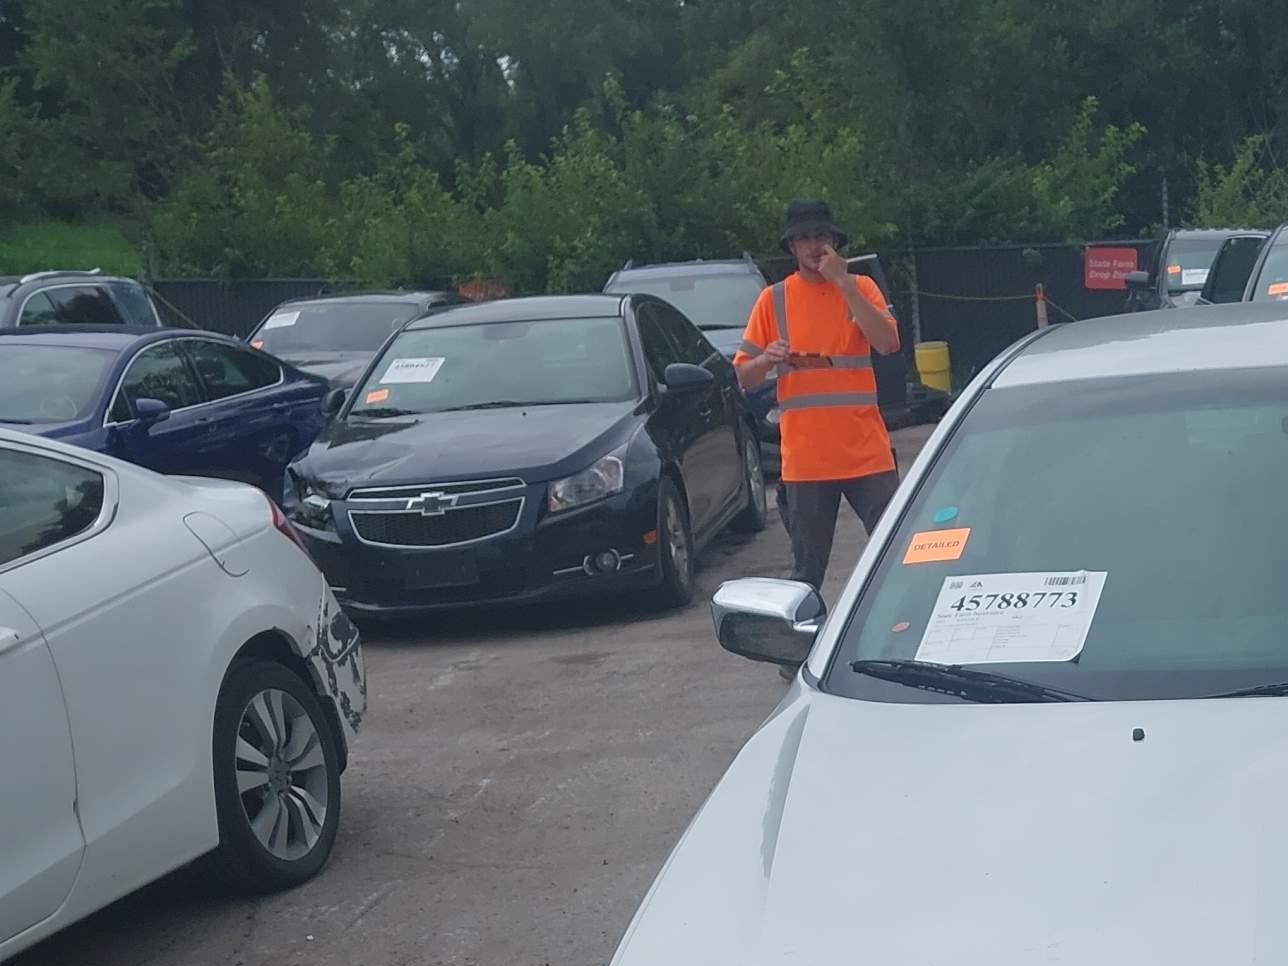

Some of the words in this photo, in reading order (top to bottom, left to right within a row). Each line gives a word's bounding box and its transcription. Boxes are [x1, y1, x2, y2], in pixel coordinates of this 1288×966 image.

[1089, 270, 1111, 280] Drop
[913, 540, 960, 551] DETAILED
[950, 591, 1078, 612] 45788773
